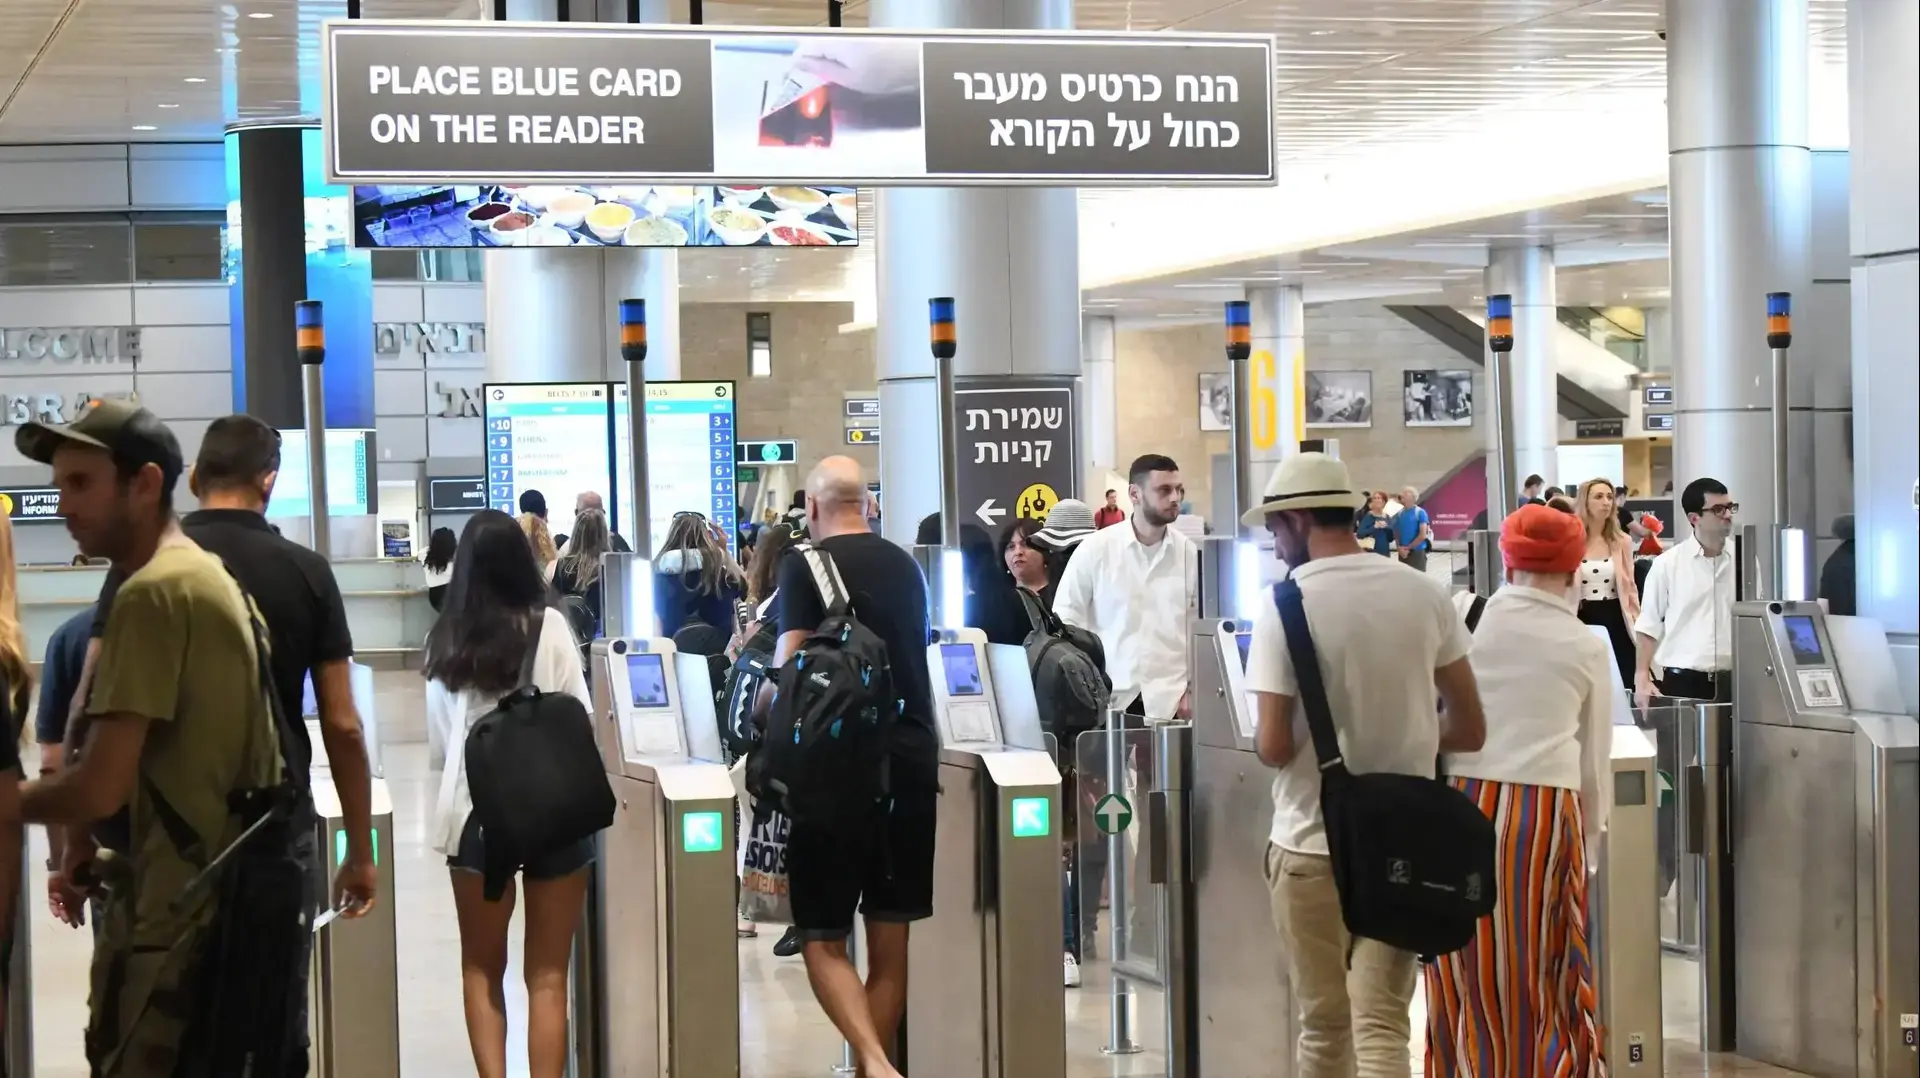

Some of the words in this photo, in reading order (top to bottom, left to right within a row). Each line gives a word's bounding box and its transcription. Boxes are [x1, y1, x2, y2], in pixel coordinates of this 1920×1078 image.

[369, 66, 480, 94] PLACE
[491, 67, 579, 96] BLUE
[589, 68, 682, 97] CARD
[1060, 72, 1163, 103] כרטיס
[953, 71, 1048, 105] מעבר
[1175, 74, 1240, 103] הנח
[370, 113, 420, 144] ON
[429, 114, 498, 144] THE
[508, 115, 645, 145] READER
[1107, 112, 1151, 152] על
[1163, 112, 1240, 148] כחול
[989, 118, 1095, 155] הקורא
[496, 419, 510, 430] 10
[713, 416, 721, 427] 3
[965, 407, 1063, 431] שמירת
[499, 436, 508, 447] 9
[714, 432, 722, 443] 5
[500, 453, 508, 464] 8
[714, 449, 722, 460] 5
[974, 440, 1052, 468] קניות
[501, 470, 509, 481] 7
[715, 465, 723, 476] 6
[502, 487, 510, 498] 7
[715, 482, 723, 493] 4
[22, 494, 60, 506] מודיעין
[716, 498, 724, 509] 3
[716, 514, 724, 526] 5
[1906, 1030, 1914, 1044] 6
[1632, 1046, 1640, 1060] 5
